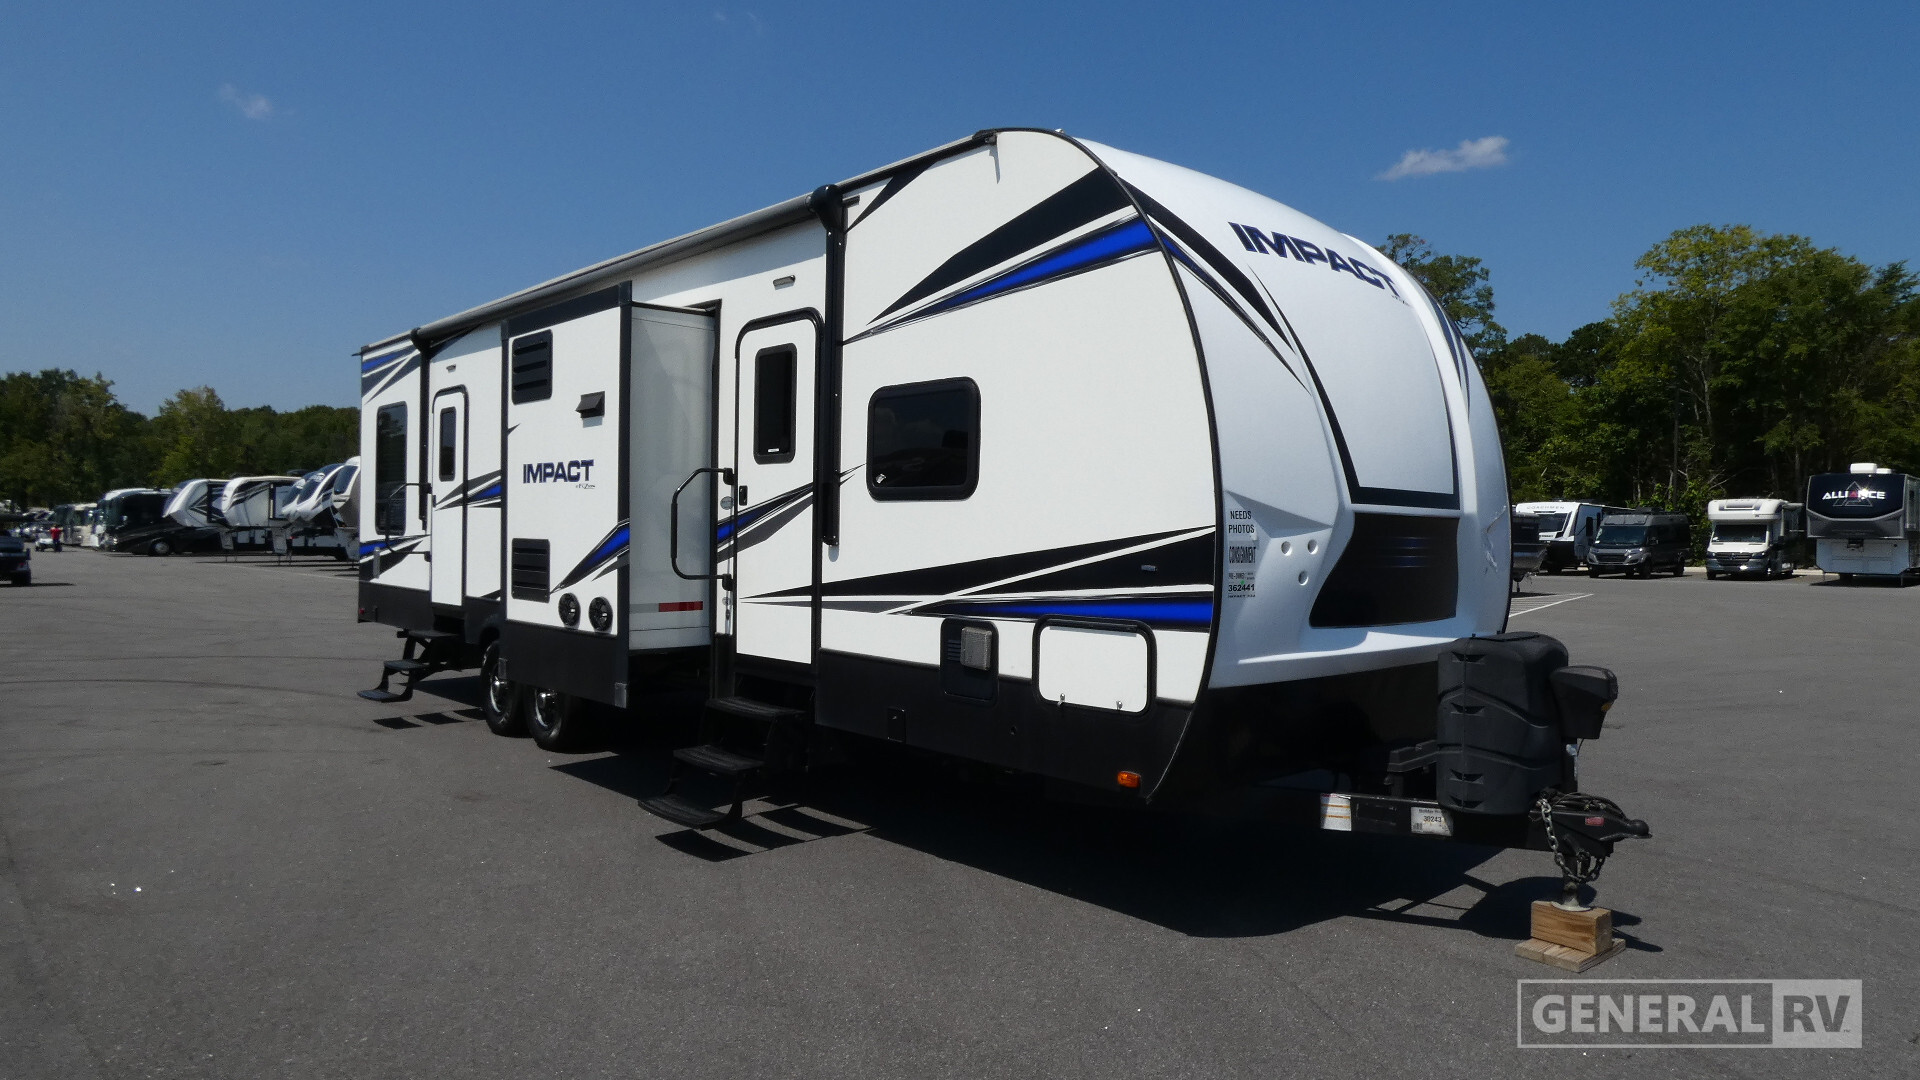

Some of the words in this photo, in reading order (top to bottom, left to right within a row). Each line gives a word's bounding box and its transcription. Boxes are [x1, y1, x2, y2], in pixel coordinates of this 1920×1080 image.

[1227, 221, 1400, 297] IMPACT
[522, 459, 594, 484] IMPACT
[1822, 490, 1886, 500] ALLIANCE
[1230, 510, 1252, 520] NEEDS
[1228, 524, 1255, 534] PHOTOS
[1228, 584, 1255, 592] 362441
